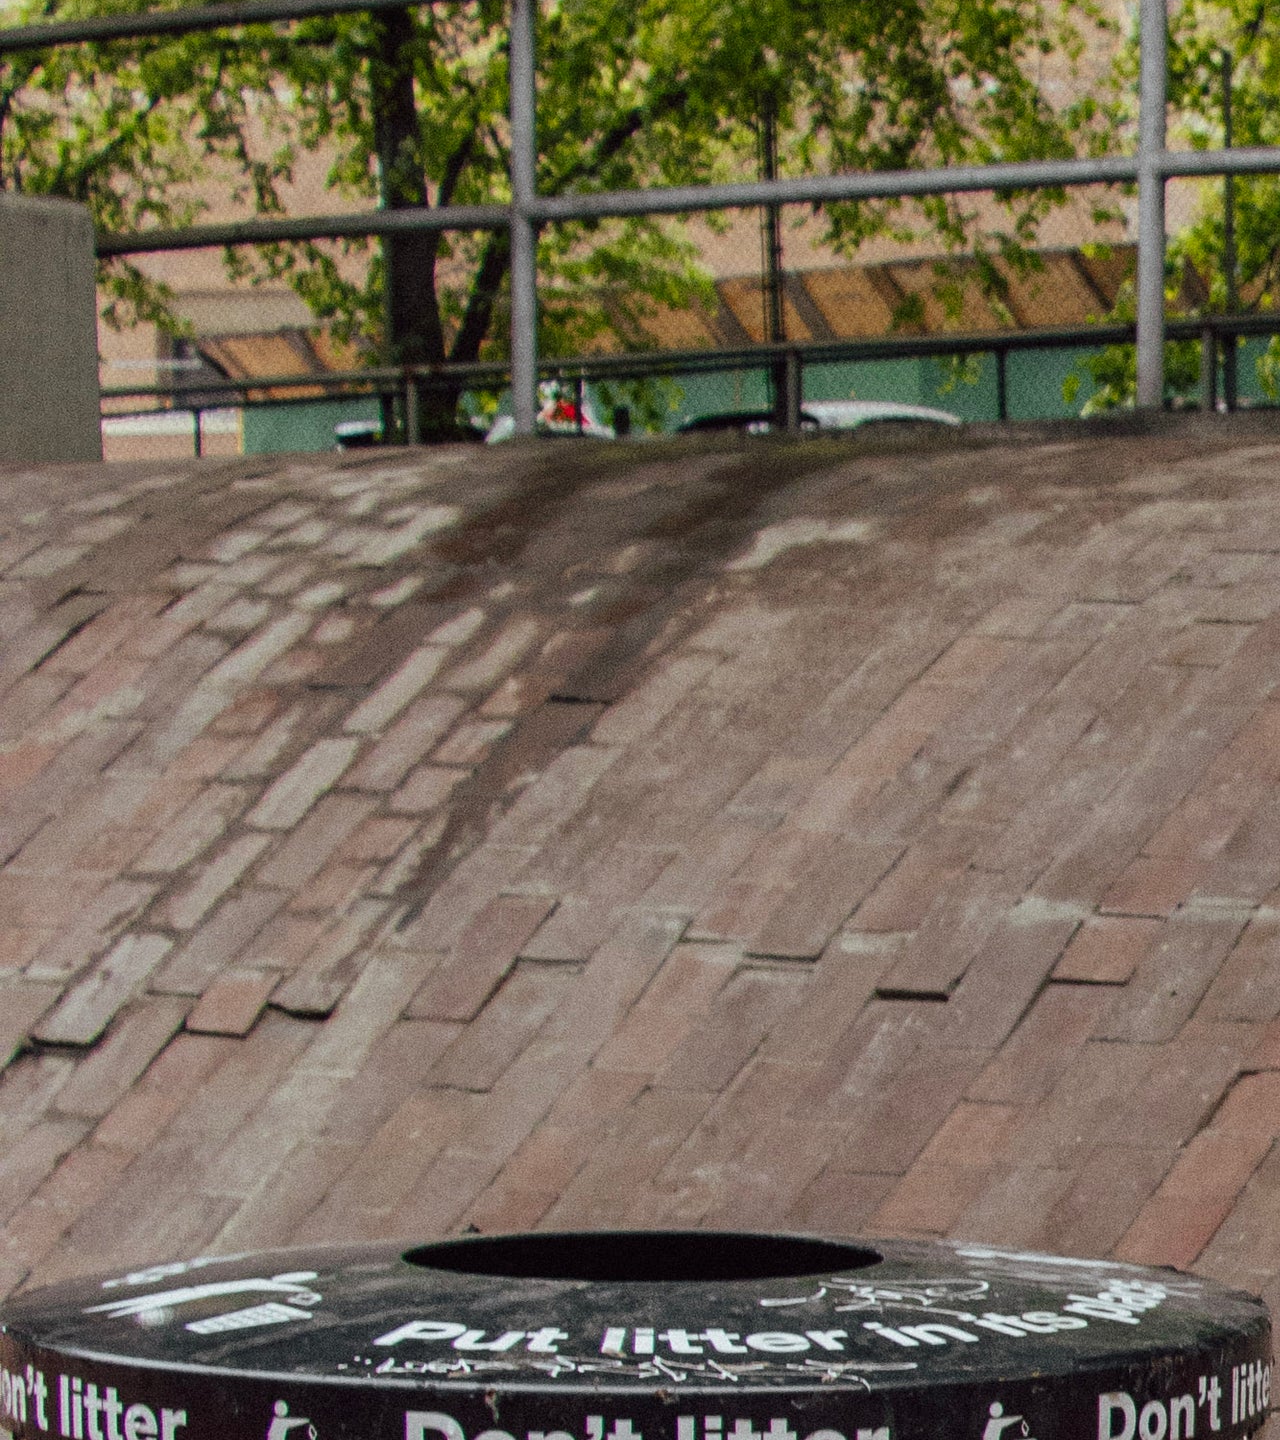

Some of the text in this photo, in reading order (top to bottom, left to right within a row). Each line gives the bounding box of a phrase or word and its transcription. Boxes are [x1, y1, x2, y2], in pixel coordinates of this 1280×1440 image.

[374, 1320, 569, 1353] Put
[600, 1325, 848, 1355] litter
[864, 1320, 979, 1348] in
